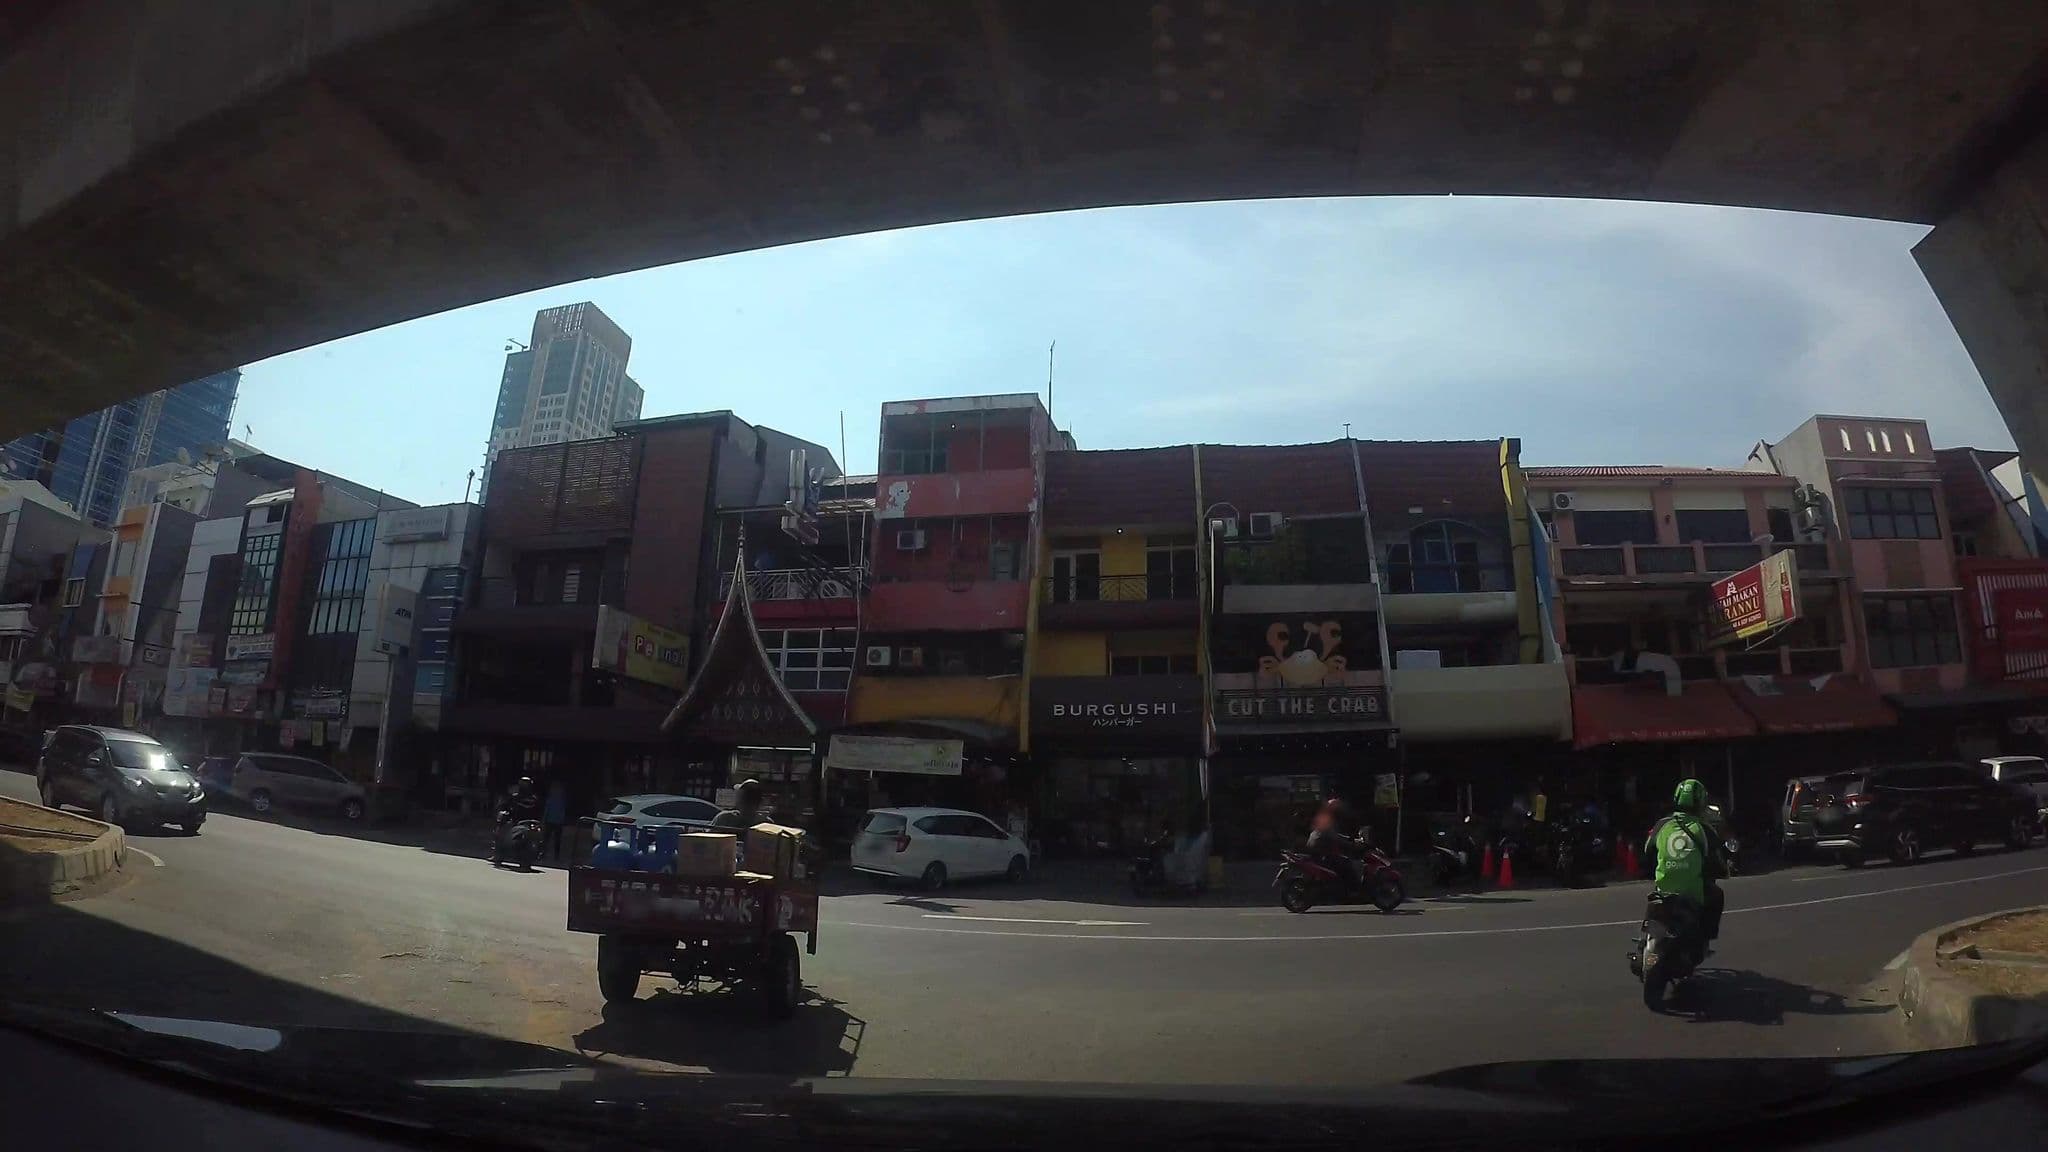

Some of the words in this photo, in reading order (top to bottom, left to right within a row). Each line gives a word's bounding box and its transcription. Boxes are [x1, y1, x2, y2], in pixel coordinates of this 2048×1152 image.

[1732, 585, 1758, 602] MAKAN
[1053, 702, 1177, 716] BURGUSHI
[1228, 697, 1266, 716] CUT
[1279, 697, 1315, 715] THE
[1328, 696, 1379, 714] CRAB
[1092, 717, 1143, 727] ハンバーガー
